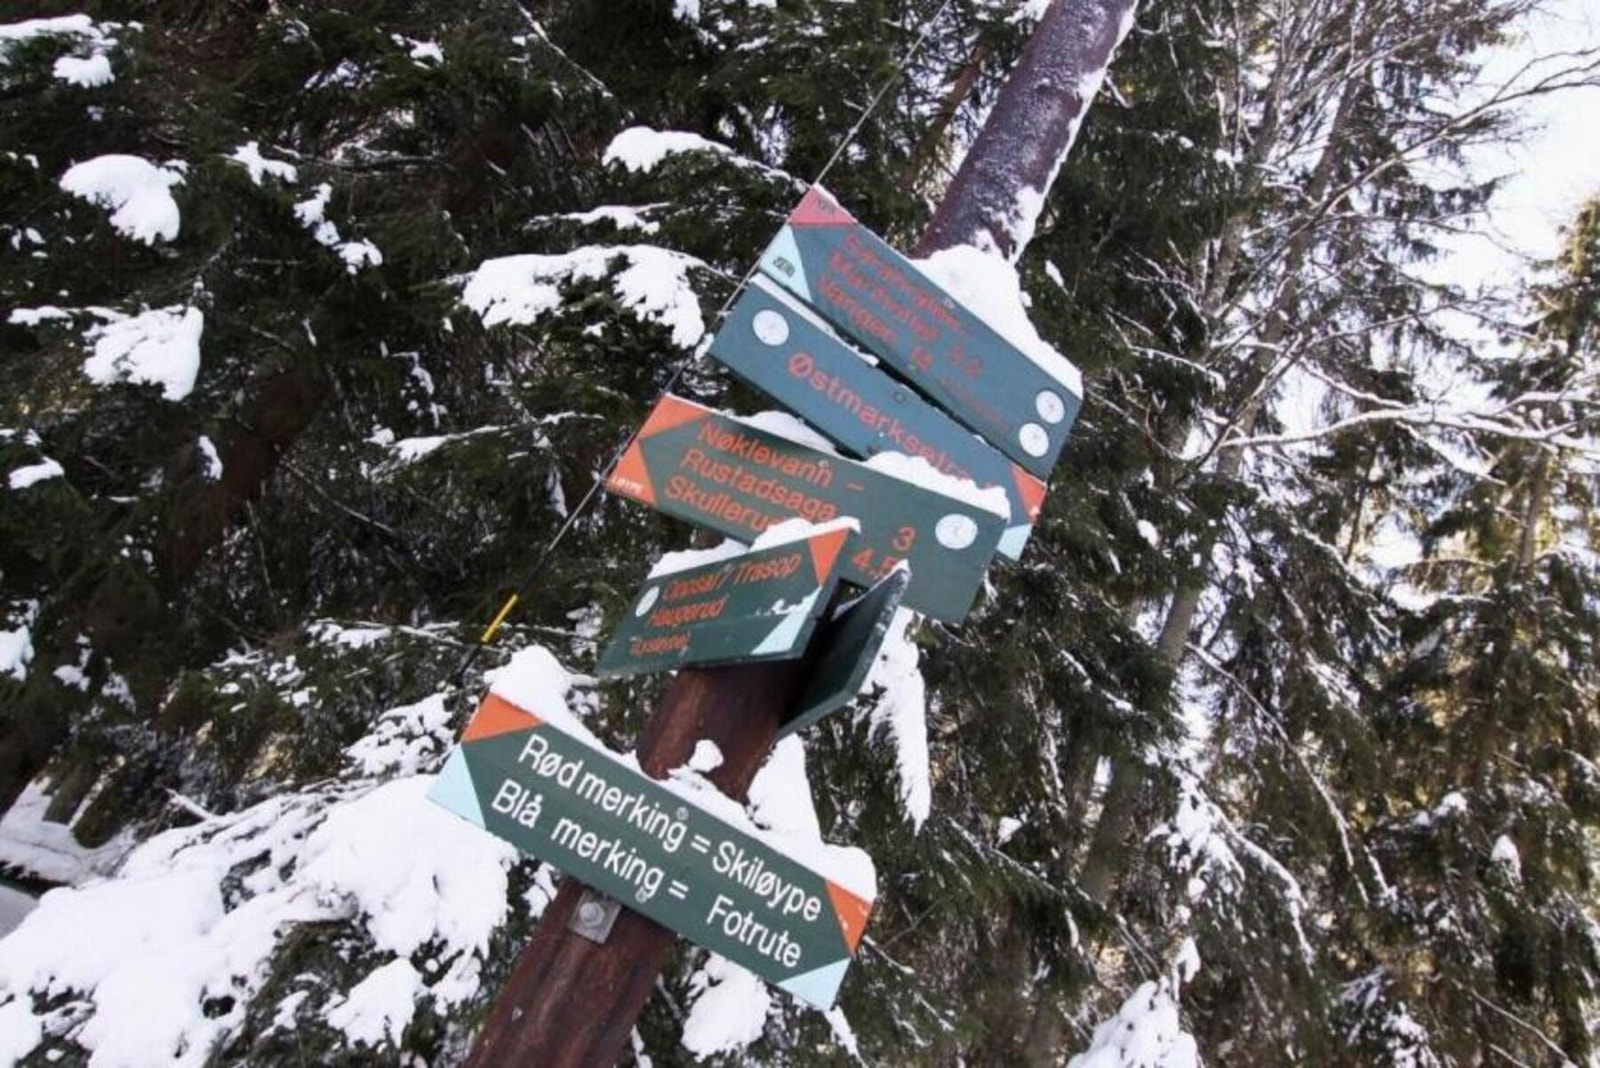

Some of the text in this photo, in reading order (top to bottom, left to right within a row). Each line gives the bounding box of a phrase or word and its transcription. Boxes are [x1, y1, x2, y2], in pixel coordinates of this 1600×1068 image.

[663, 474, 786, 533] Skulleru
[680, 447, 916, 552] Rustadsaga 3
[697, 421, 833, 487] Nøklevann
[490, 778, 543, 828] Blå
[550, 813, 665, 899] merking
[705, 893, 803, 969] Fotrute
[517, 733, 580, 788] Rød
[574, 770, 688, 854] merking
[712, 839, 823, 923] Skiløype
